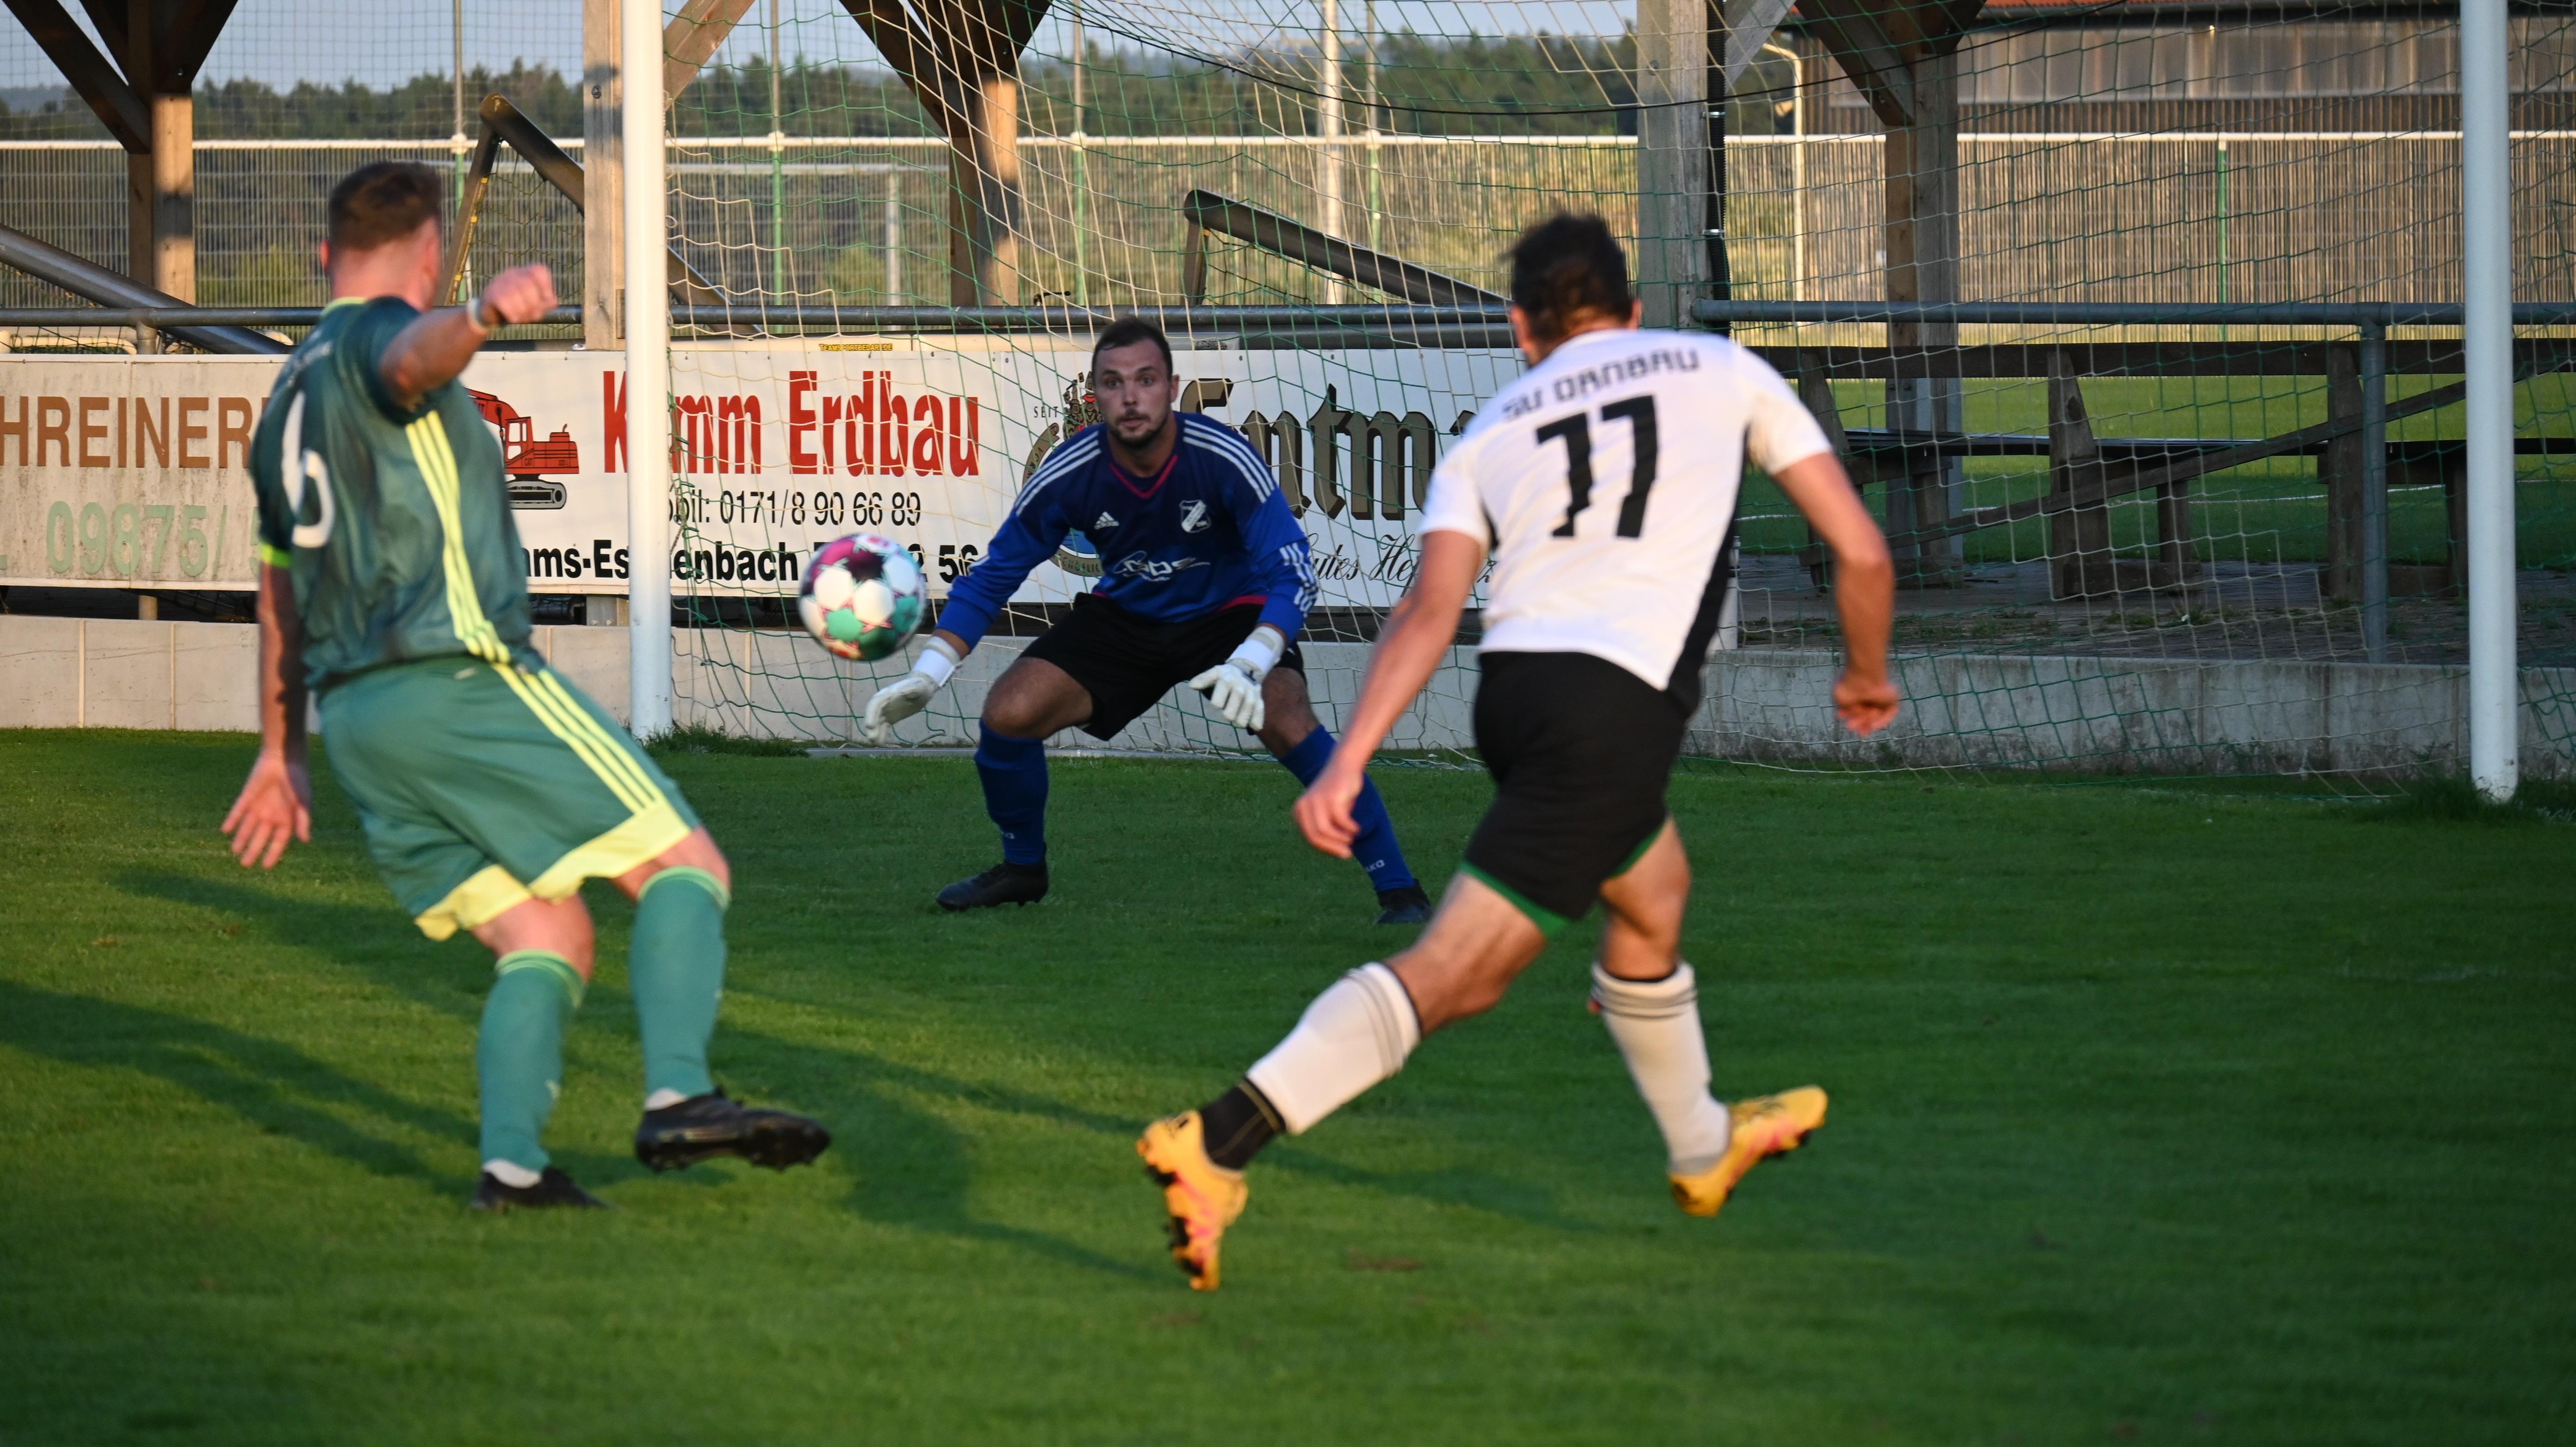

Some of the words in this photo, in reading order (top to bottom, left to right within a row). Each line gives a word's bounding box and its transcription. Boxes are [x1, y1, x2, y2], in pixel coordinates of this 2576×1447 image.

[0, 396, 269, 468] HREINER
[603, 371, 761, 474] Kmm
[789, 371, 979, 477] Erdbau
[1034, 406, 1059, 418] SEIT
[720, 489, 805, 527] 0171/8
[814, 492, 844, 526] 90
[854, 492, 883, 526] 66
[892, 492, 921, 526] 89
